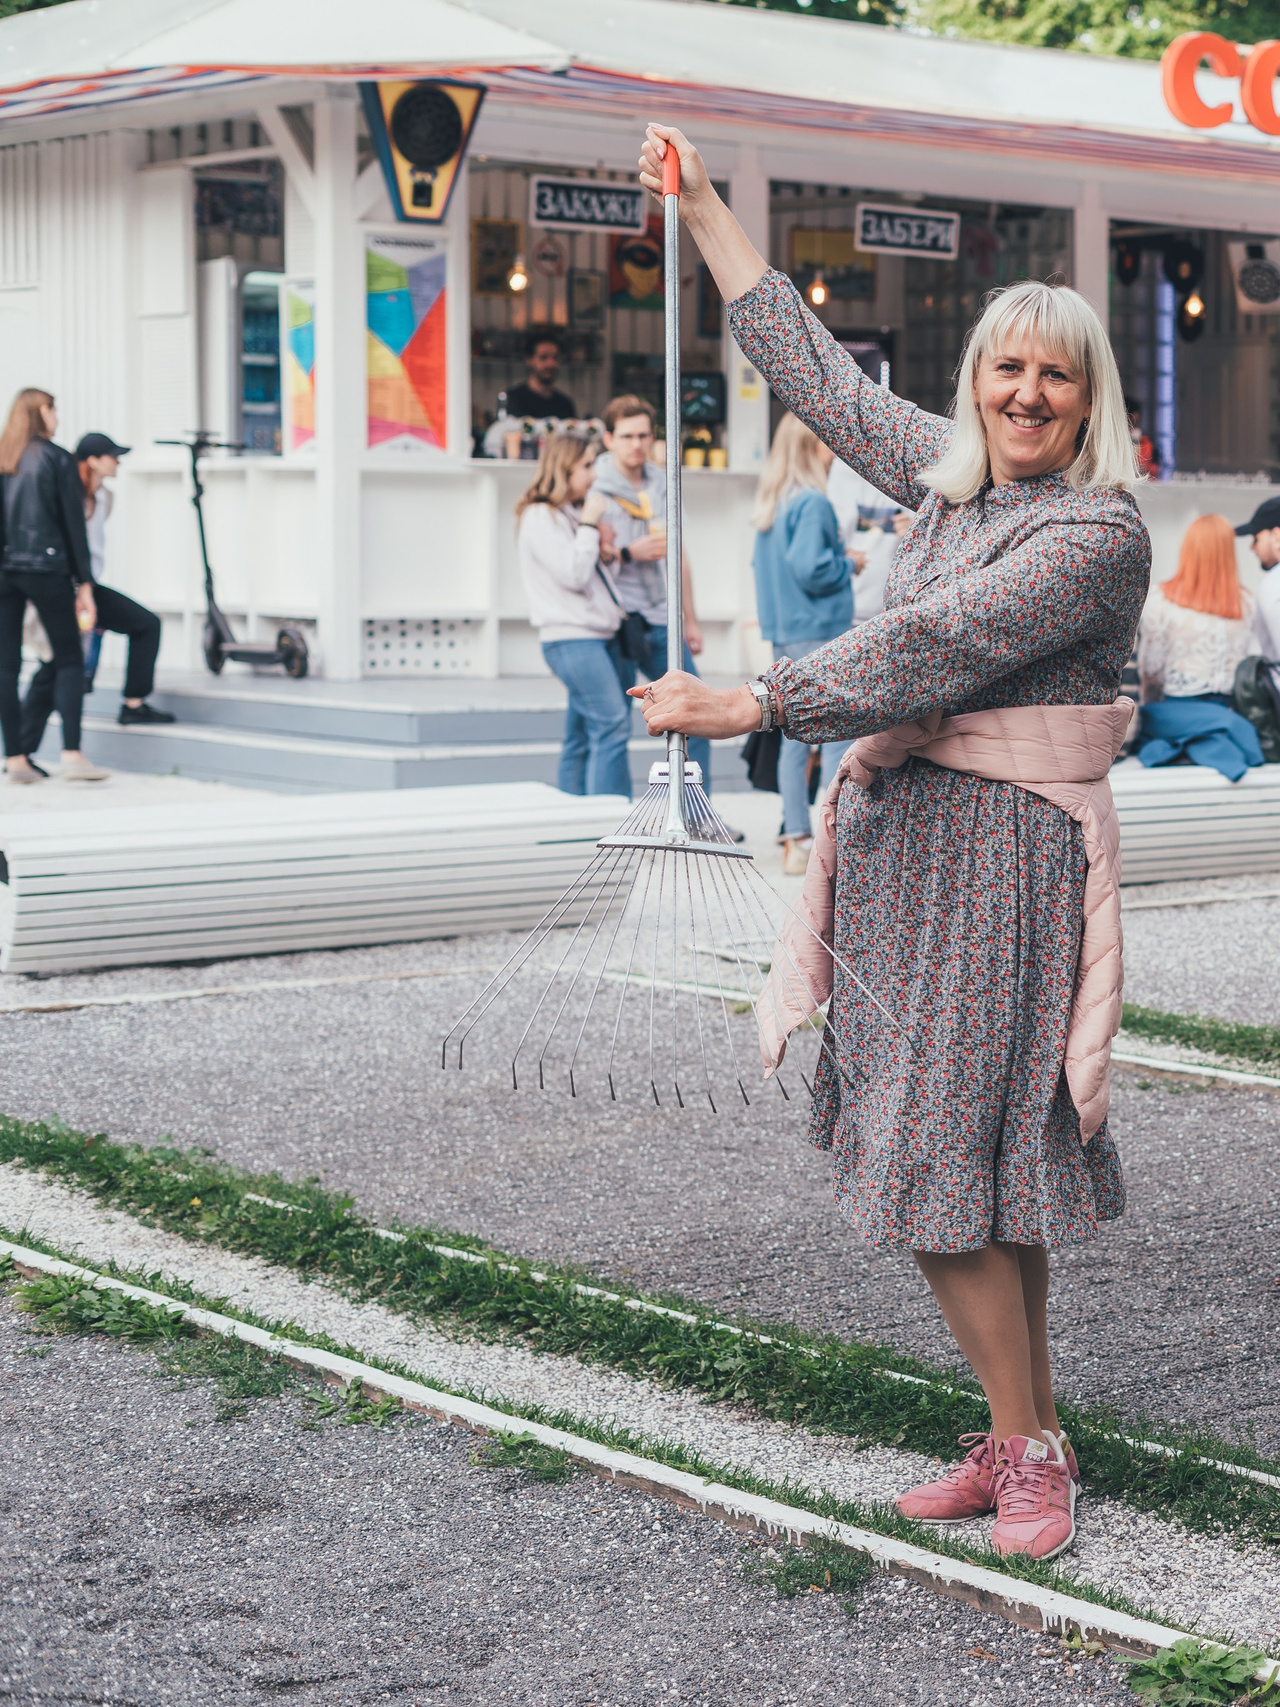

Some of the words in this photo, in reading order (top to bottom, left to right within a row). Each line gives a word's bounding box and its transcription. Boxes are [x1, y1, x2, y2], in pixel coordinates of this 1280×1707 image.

[538, 186, 642, 222] ЗАКАЖИ
[863, 214, 953, 248] ЗАБЕРИ
[1028, 1453, 1041, 1462] 996
